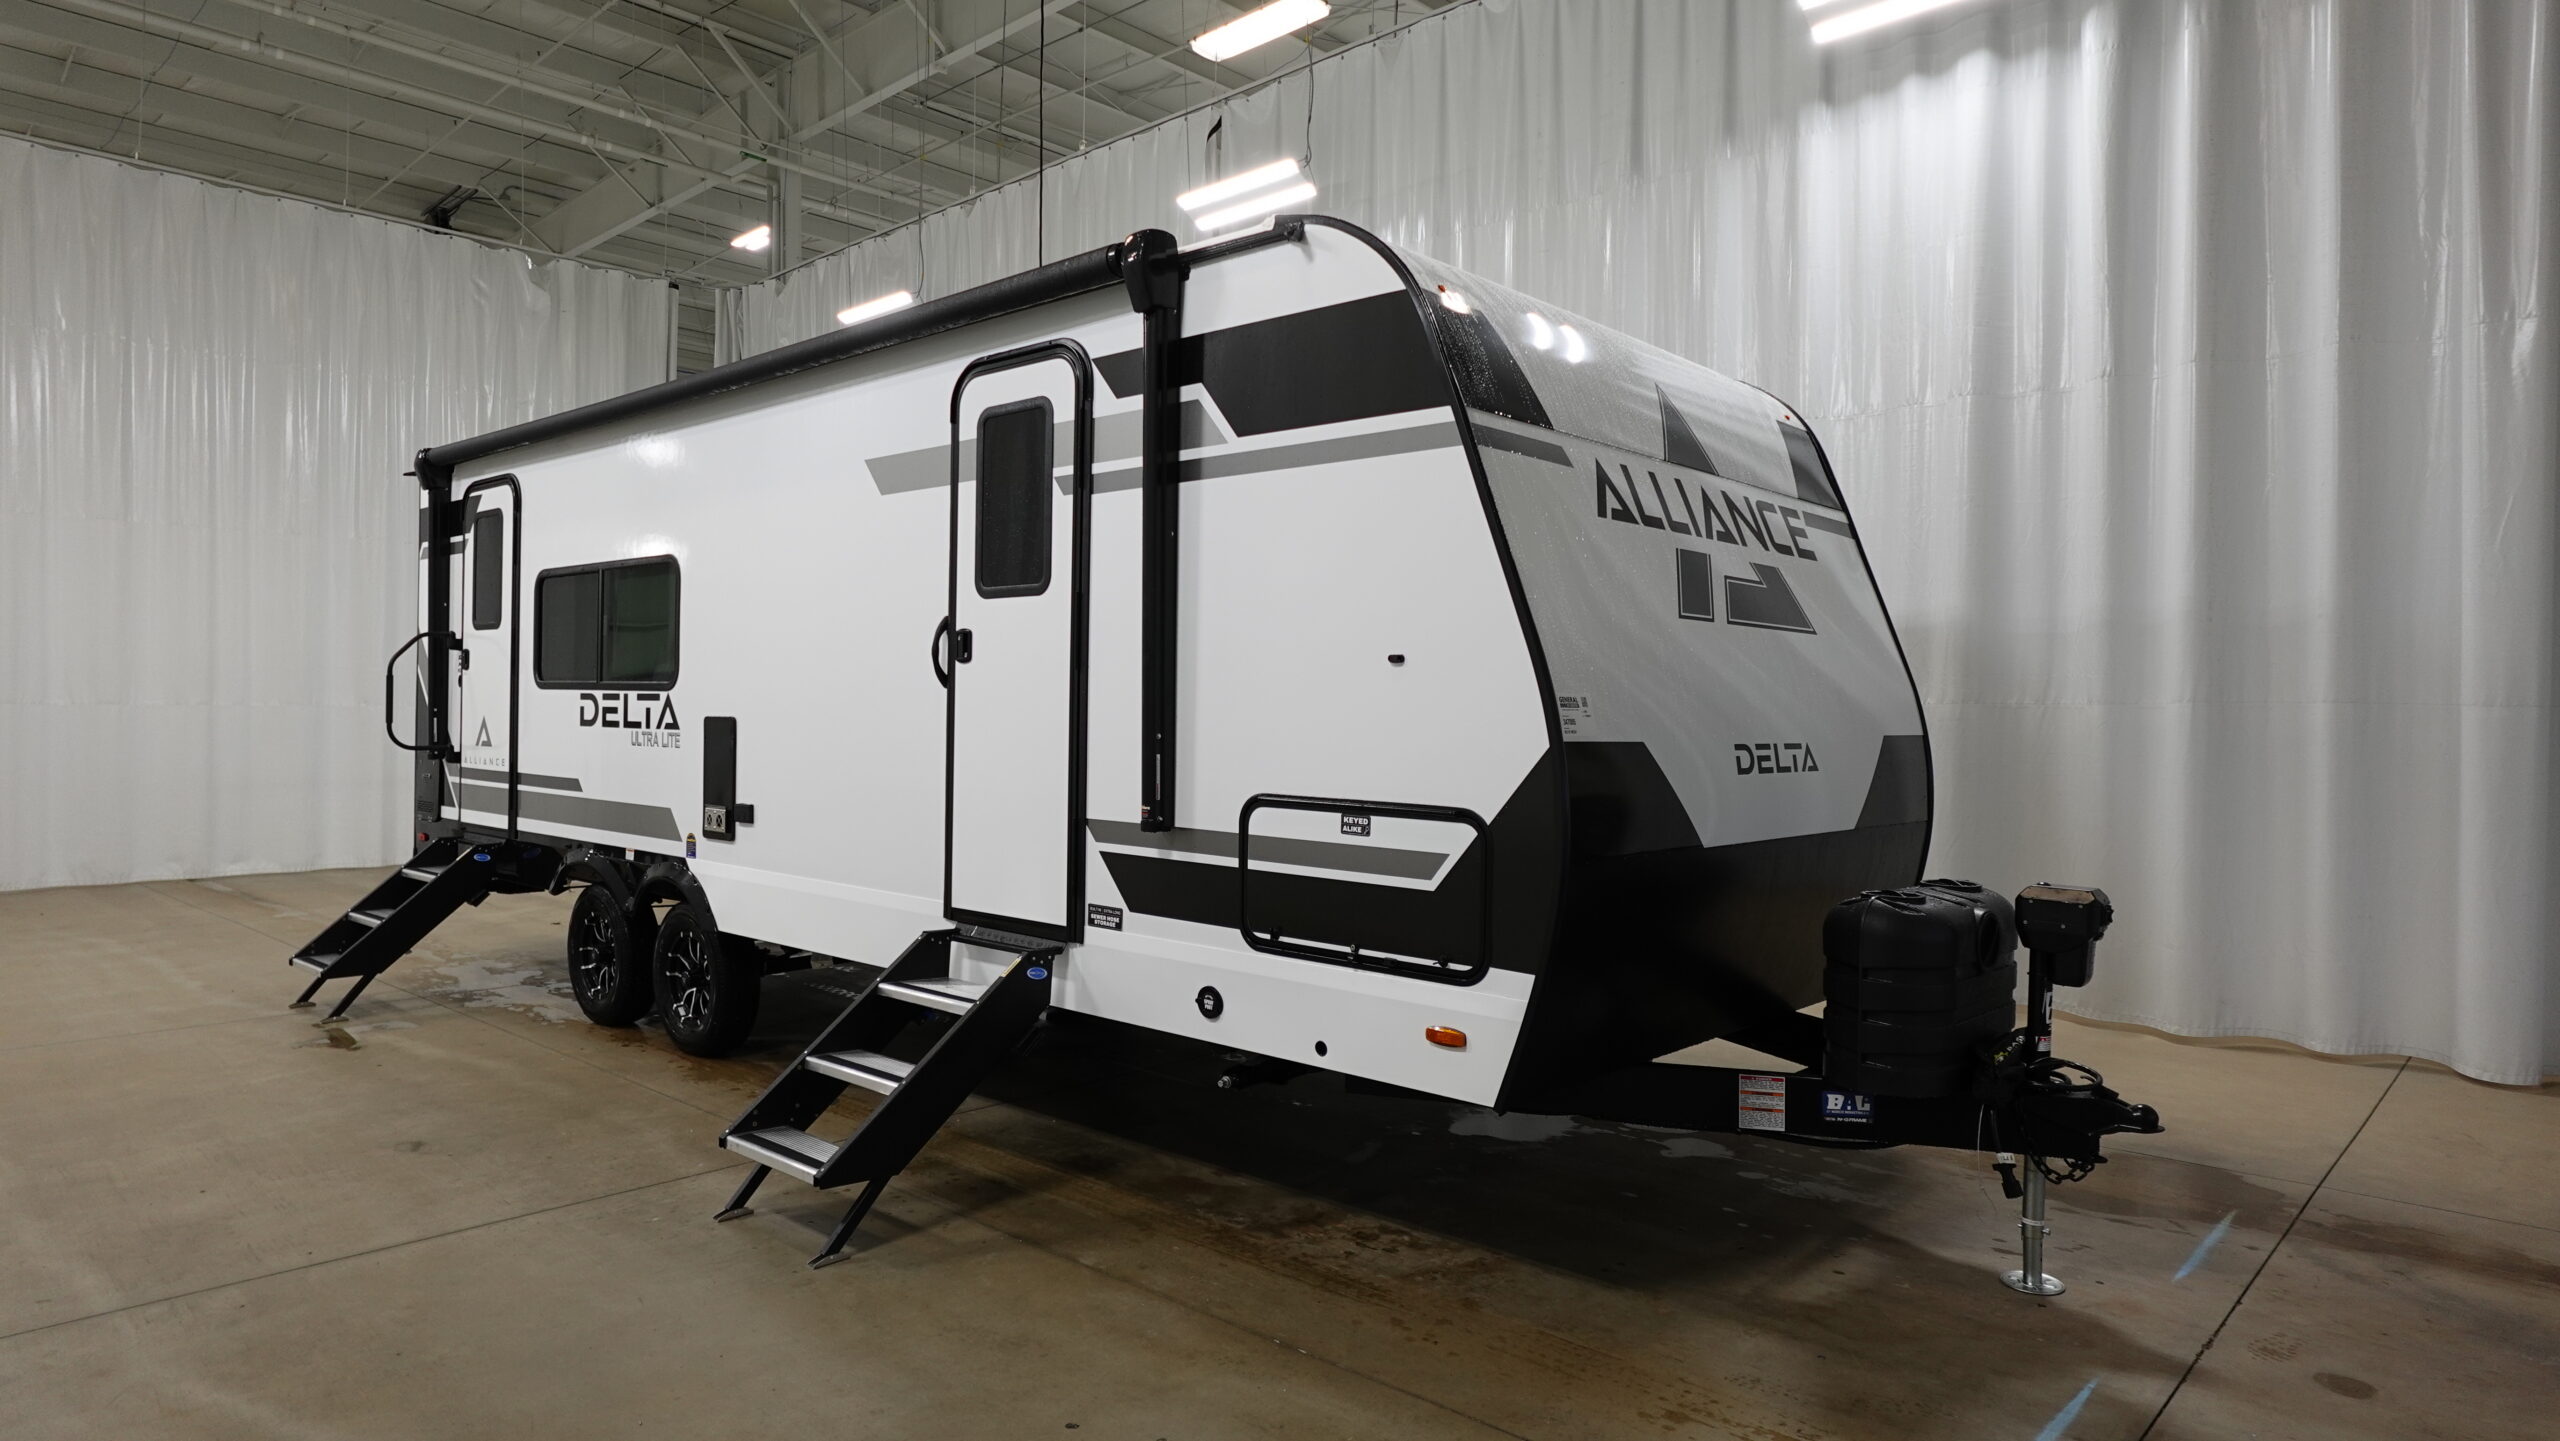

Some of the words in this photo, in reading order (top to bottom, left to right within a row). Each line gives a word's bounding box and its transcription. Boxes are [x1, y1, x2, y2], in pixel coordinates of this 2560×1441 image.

[1595, 457, 1818, 562] ALLIANCE
[579, 692, 680, 730] DELTA
[631, 731, 659, 747] ULTRA
[661, 732, 680, 748] LITE
[464, 756, 505, 767] ALLIANCE
[1734, 742, 1819, 775] DELTA
[1343, 816, 1369, 825] KEYED
[1342, 825, 1362, 833] ALIKE
[1094, 919, 1116, 927] STORAGE
[1106, 915, 1120, 923] HOSE
